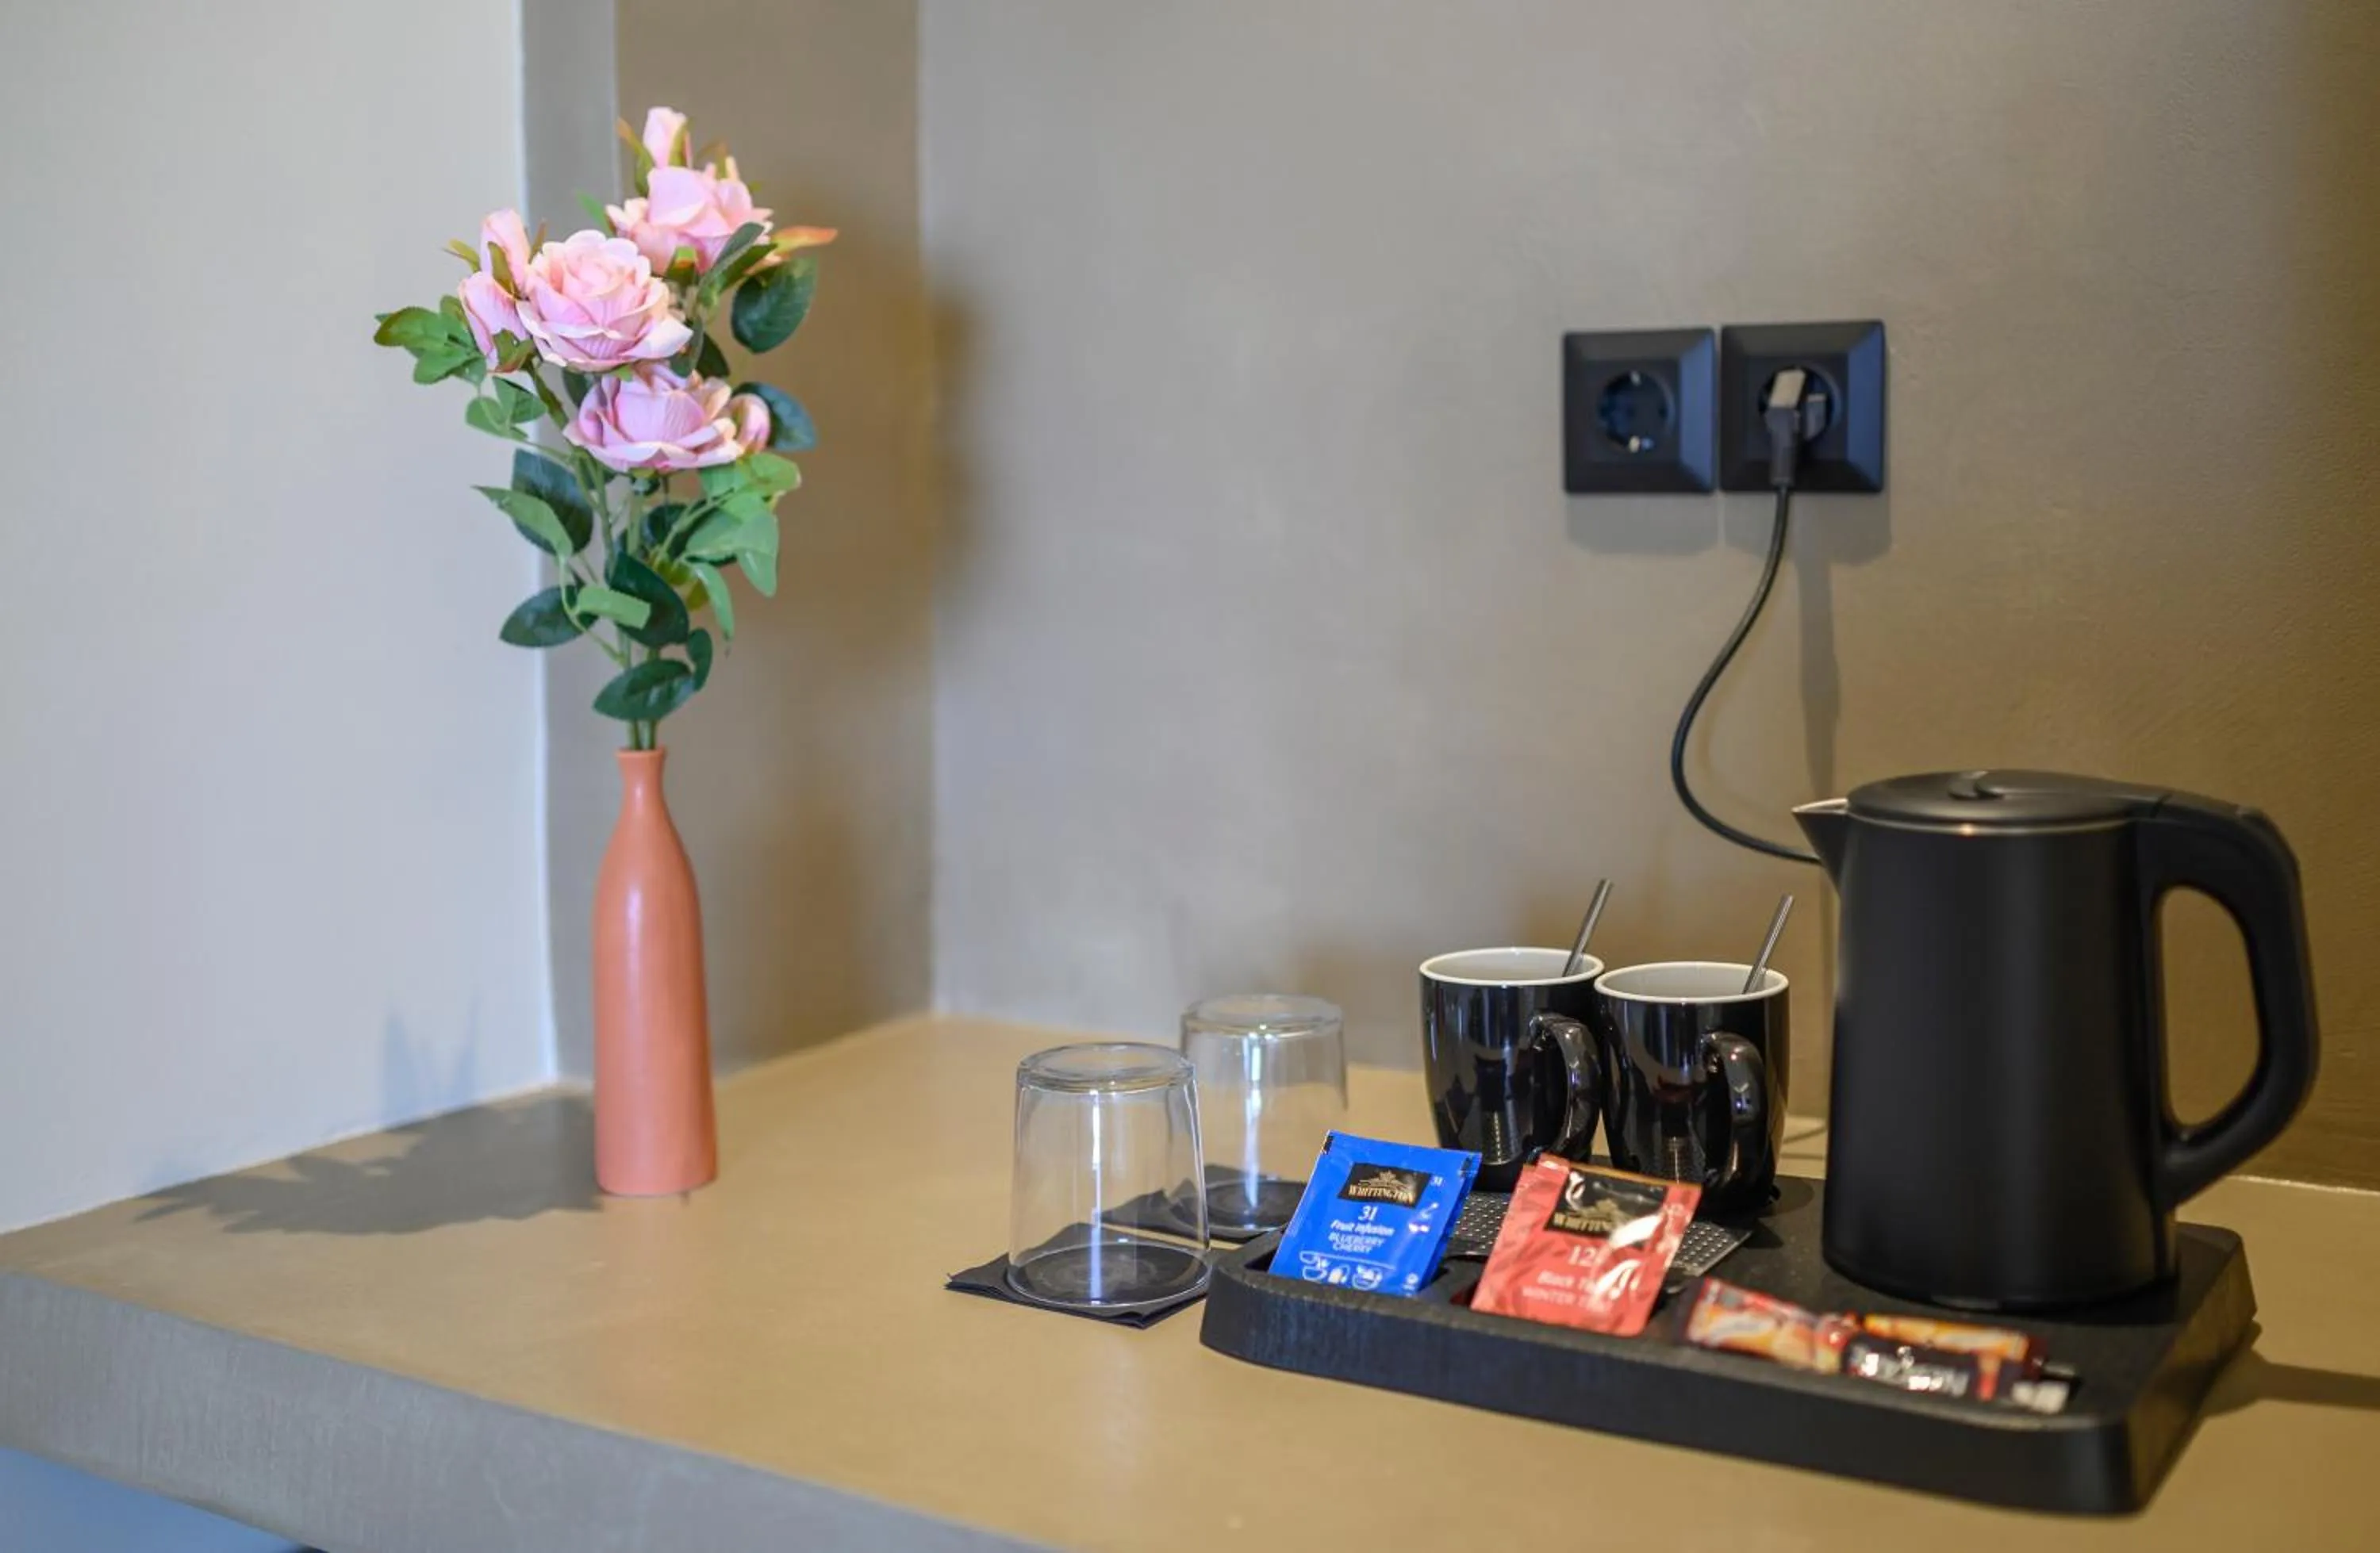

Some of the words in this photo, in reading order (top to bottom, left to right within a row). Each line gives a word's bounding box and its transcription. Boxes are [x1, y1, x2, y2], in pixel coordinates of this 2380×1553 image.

[1349, 1184, 1415, 1204] WHITTINGTON
[1357, 1205, 1379, 1221] 31
[1328, 1232, 1385, 1246] BLUEBERRY
[1332, 1242, 1372, 1253] CHERRY
[1568, 1244, 1598, 1267] 12
